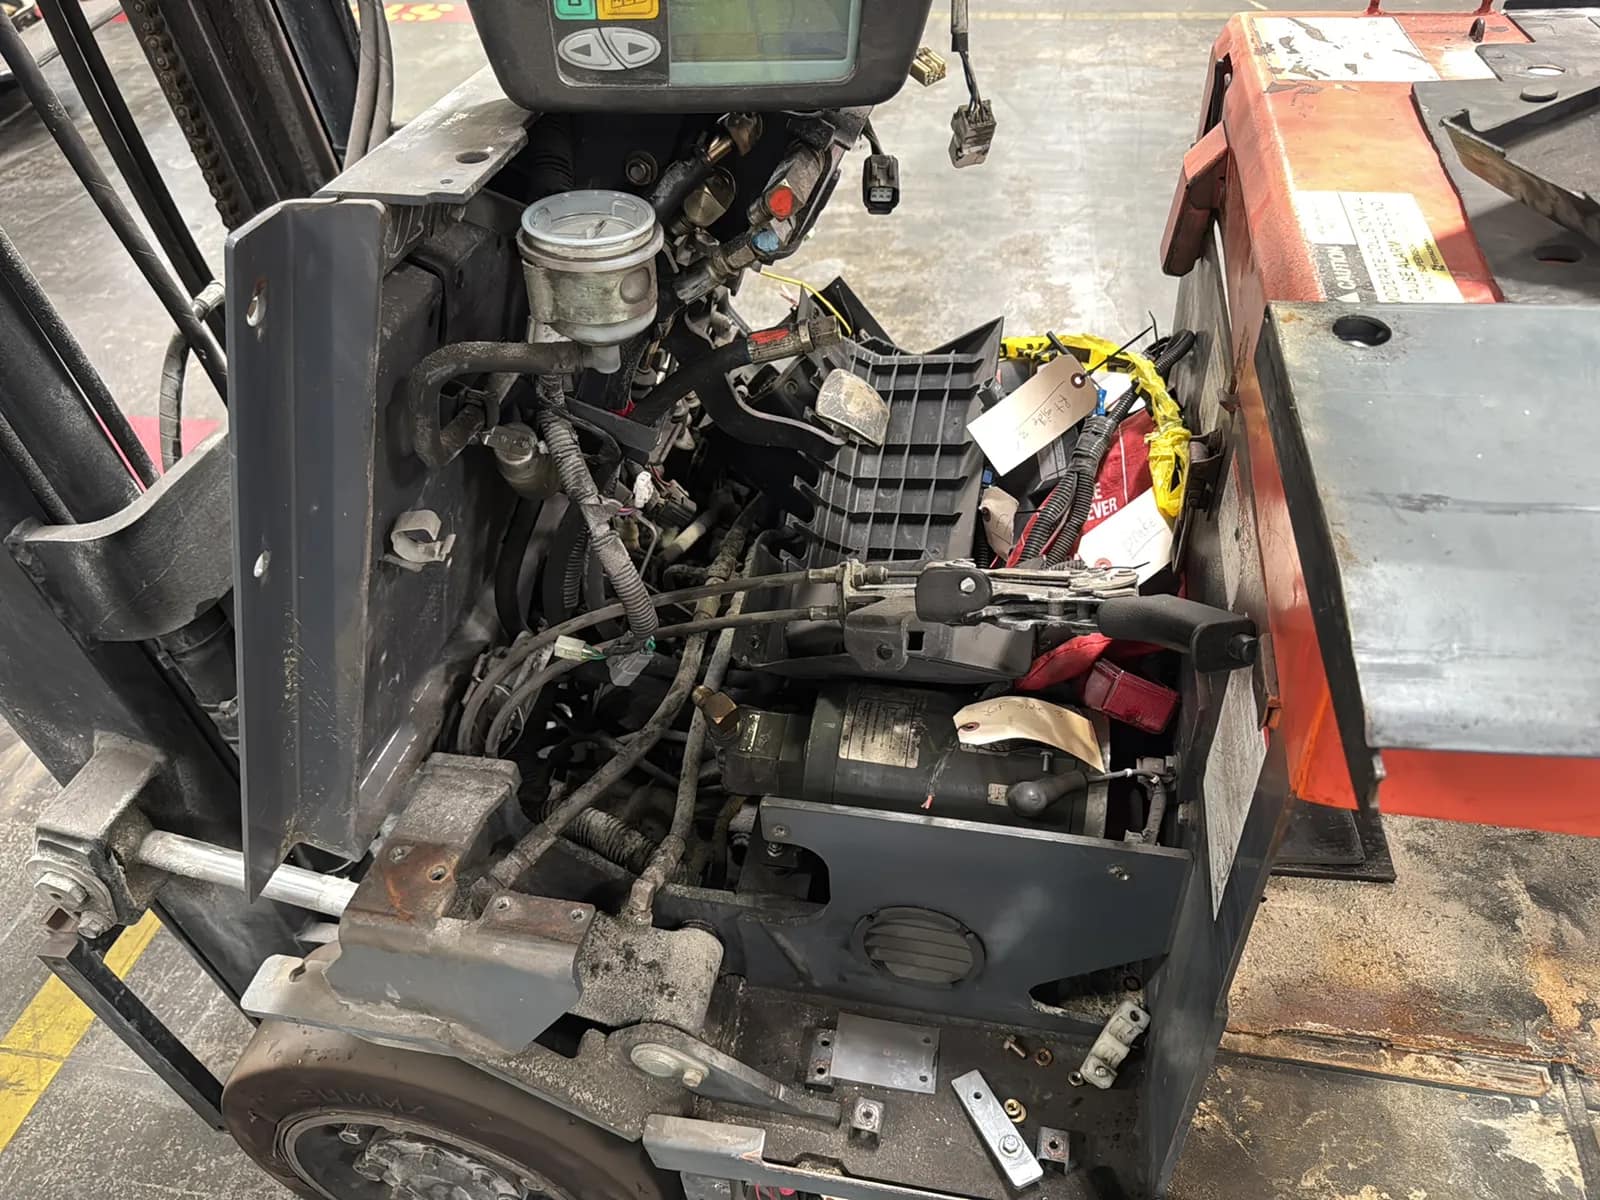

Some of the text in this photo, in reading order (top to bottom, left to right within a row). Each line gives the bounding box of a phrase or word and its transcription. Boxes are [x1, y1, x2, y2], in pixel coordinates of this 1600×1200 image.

[1327, 245, 1357, 289] CAUTION
[1387, 240, 1413, 270] ALARM
[1399, 271, 1425, 302] CAUSE
